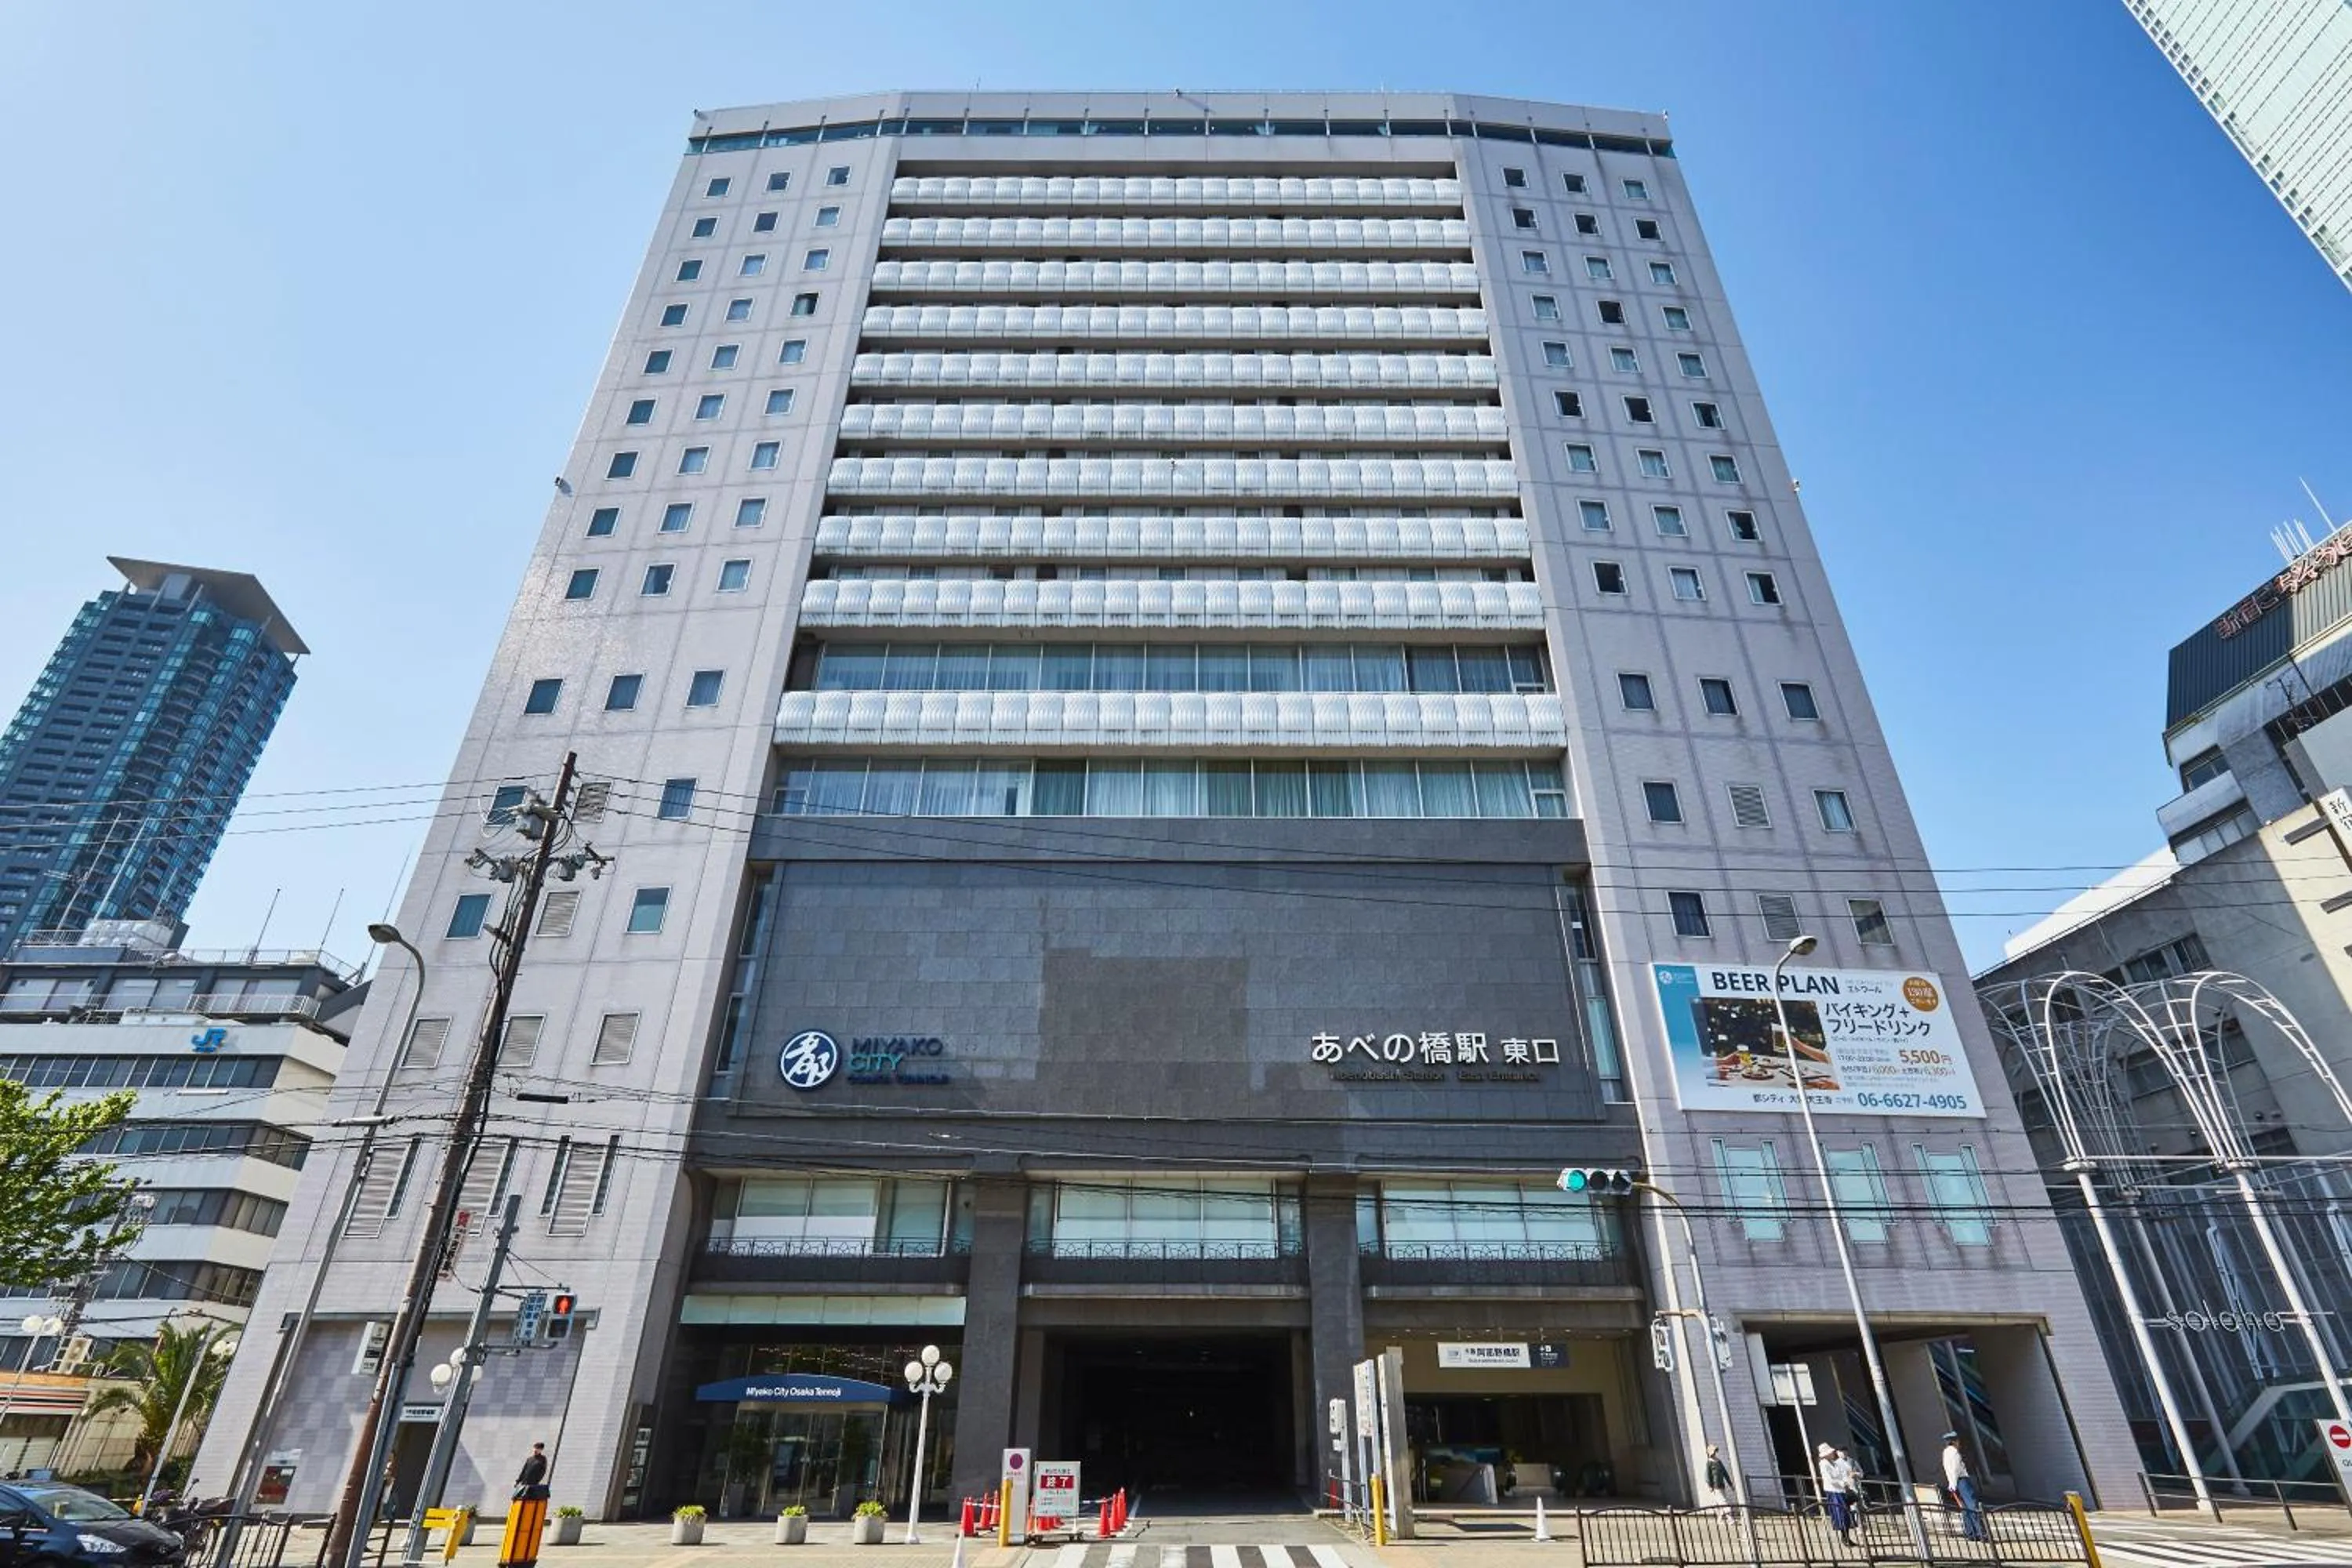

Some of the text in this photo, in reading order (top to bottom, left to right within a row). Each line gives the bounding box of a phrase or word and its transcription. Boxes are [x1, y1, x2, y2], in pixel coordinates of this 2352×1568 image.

[1711, 971, 1770, 992] BEER
[1777, 975, 1840, 994] PLAN
[1828, 1018, 1931, 1036] フリードリンク
[852, 1037, 943, 1056] MIYAKO
[1312, 1031, 1559, 1064] あべの橋駅 東口
[848, 1054, 902, 1073] CITY
[1857, 1092, 1967, 1109] 06-6627-4905
[2166, 1299, 2285, 1332] solaha
[789, 1387, 814, 1396] Osaka
[1046, 1476, 1069, 1487] 終了
